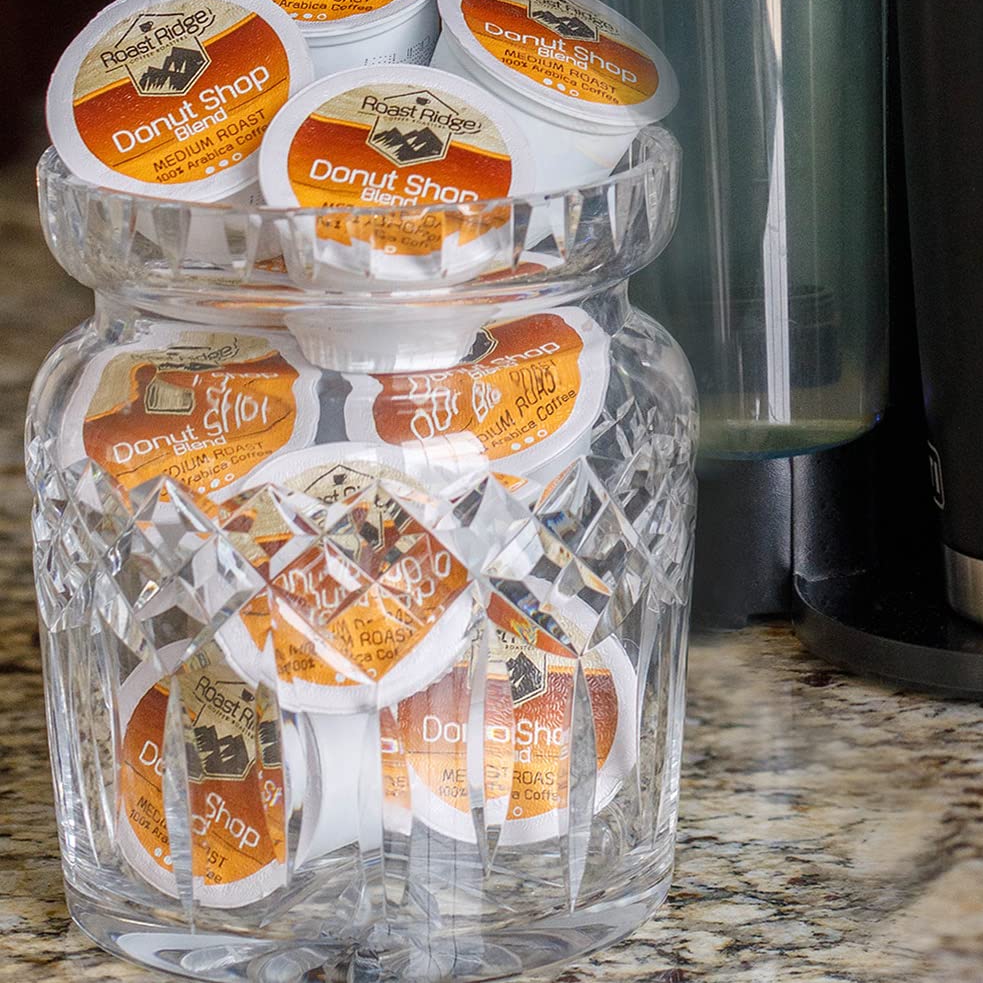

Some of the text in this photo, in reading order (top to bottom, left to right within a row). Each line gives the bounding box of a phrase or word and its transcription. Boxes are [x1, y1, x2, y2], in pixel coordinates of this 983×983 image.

[279, 0, 373, 12] Arabica Coffee
[100, 9, 209, 68] Roast Ridge
[485, 22, 638, 84] Donut Shop
[504, 49, 617, 94] MEDIUM ROAST
[537, 47, 588, 70] Blend
[501, 58, 619, 105] 100% Arabica Coffee
[112, 66, 270, 153] Donut Shop
[174, 107, 228, 142] Blend
[361, 95, 476, 132] Roast Ridge
[153, 108, 266, 172] MEDIUM ROAST
[156, 125, 268, 183] 100% Arabica Coffe
[309, 159, 401, 190] Donut
[361, 187, 418, 206] Blend
[476, 409, 516, 443] DIUM
[491, 420, 537, 447] Arabica
[536, 389, 577, 421] Coffee
[112, 424, 198, 464] Donut
[162, 442, 263, 478] DIUM ROAST
[173, 435, 226, 455] Blend
[194, 676, 241, 718] Roast
[517, 718, 565, 746] Sho
[513, 770, 555, 786] ROAS
[130, 809, 151, 830] 100%
[205, 792, 261, 849] Shop
